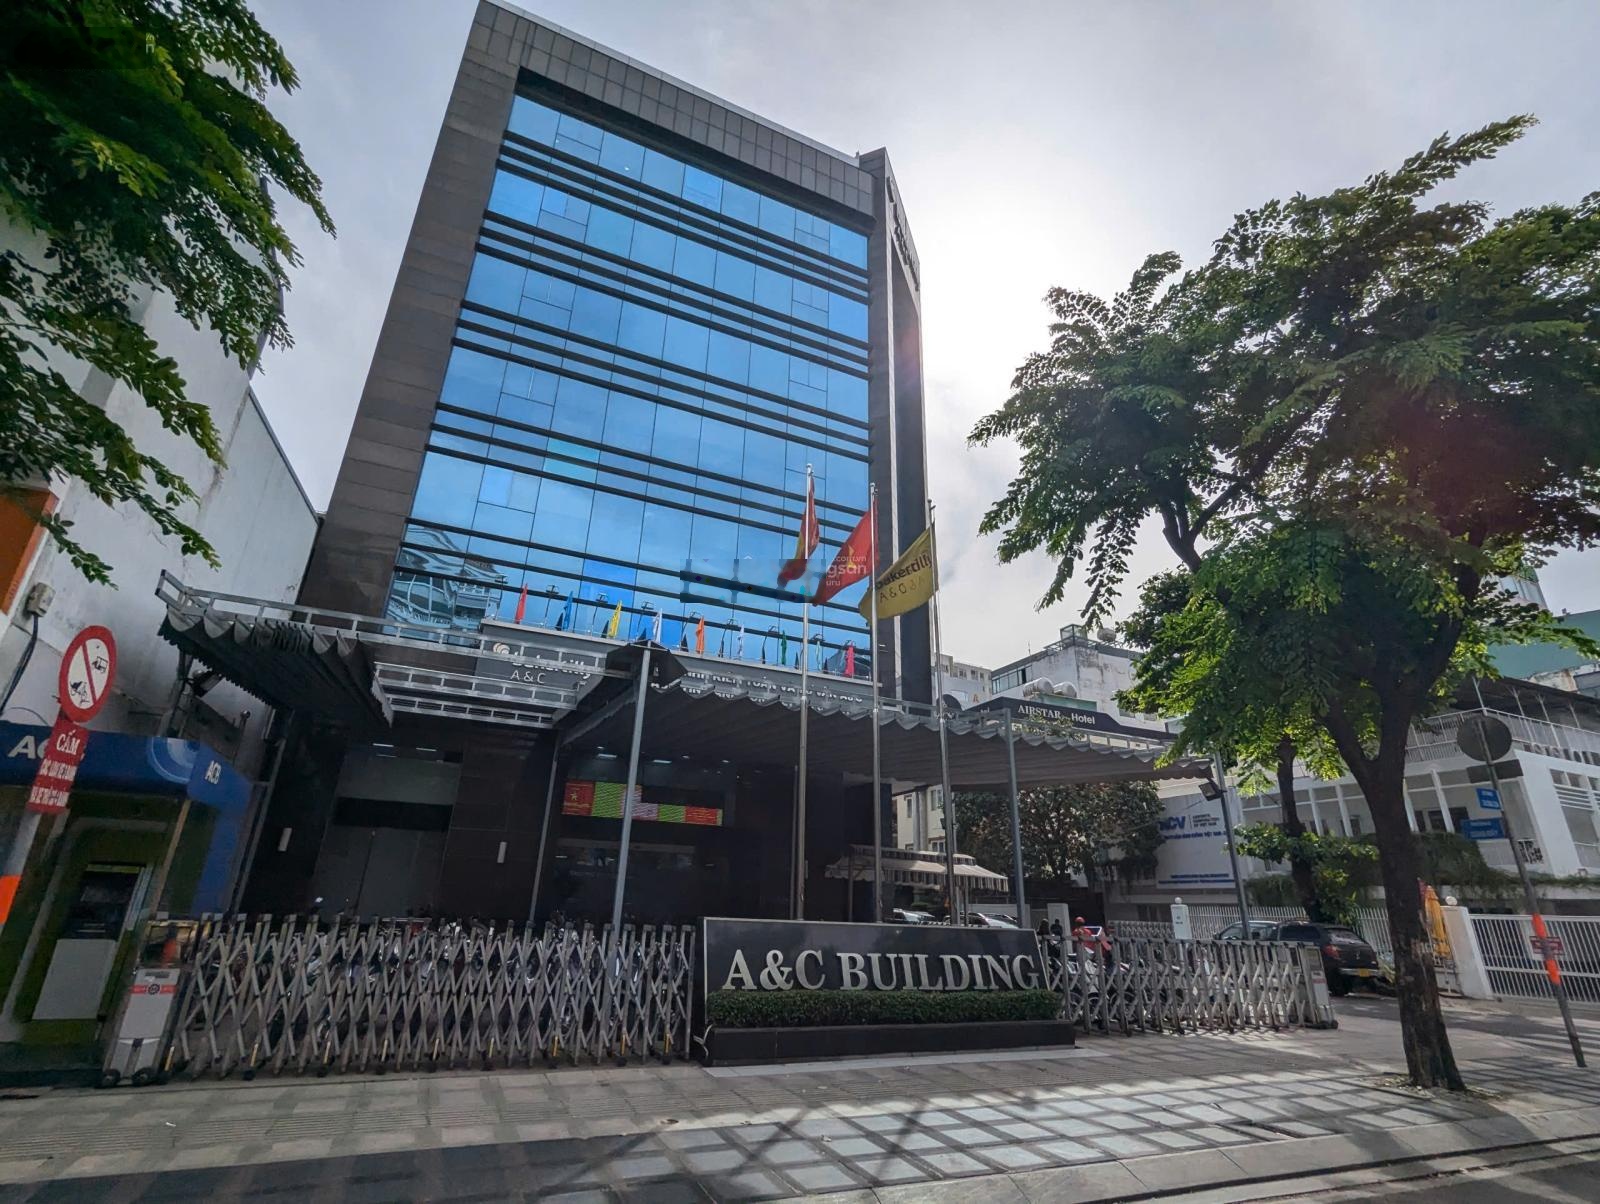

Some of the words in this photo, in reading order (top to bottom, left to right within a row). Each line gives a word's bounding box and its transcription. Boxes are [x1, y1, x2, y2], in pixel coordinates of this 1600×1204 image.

[1018, 704, 1062, 719] AIRSTAR
[1071, 712, 1096, 725] Hotel
[56, 729, 80, 755] CẤM
[722, 949, 826, 990] A&C
[836, 952, 1039, 991] BUILDING
